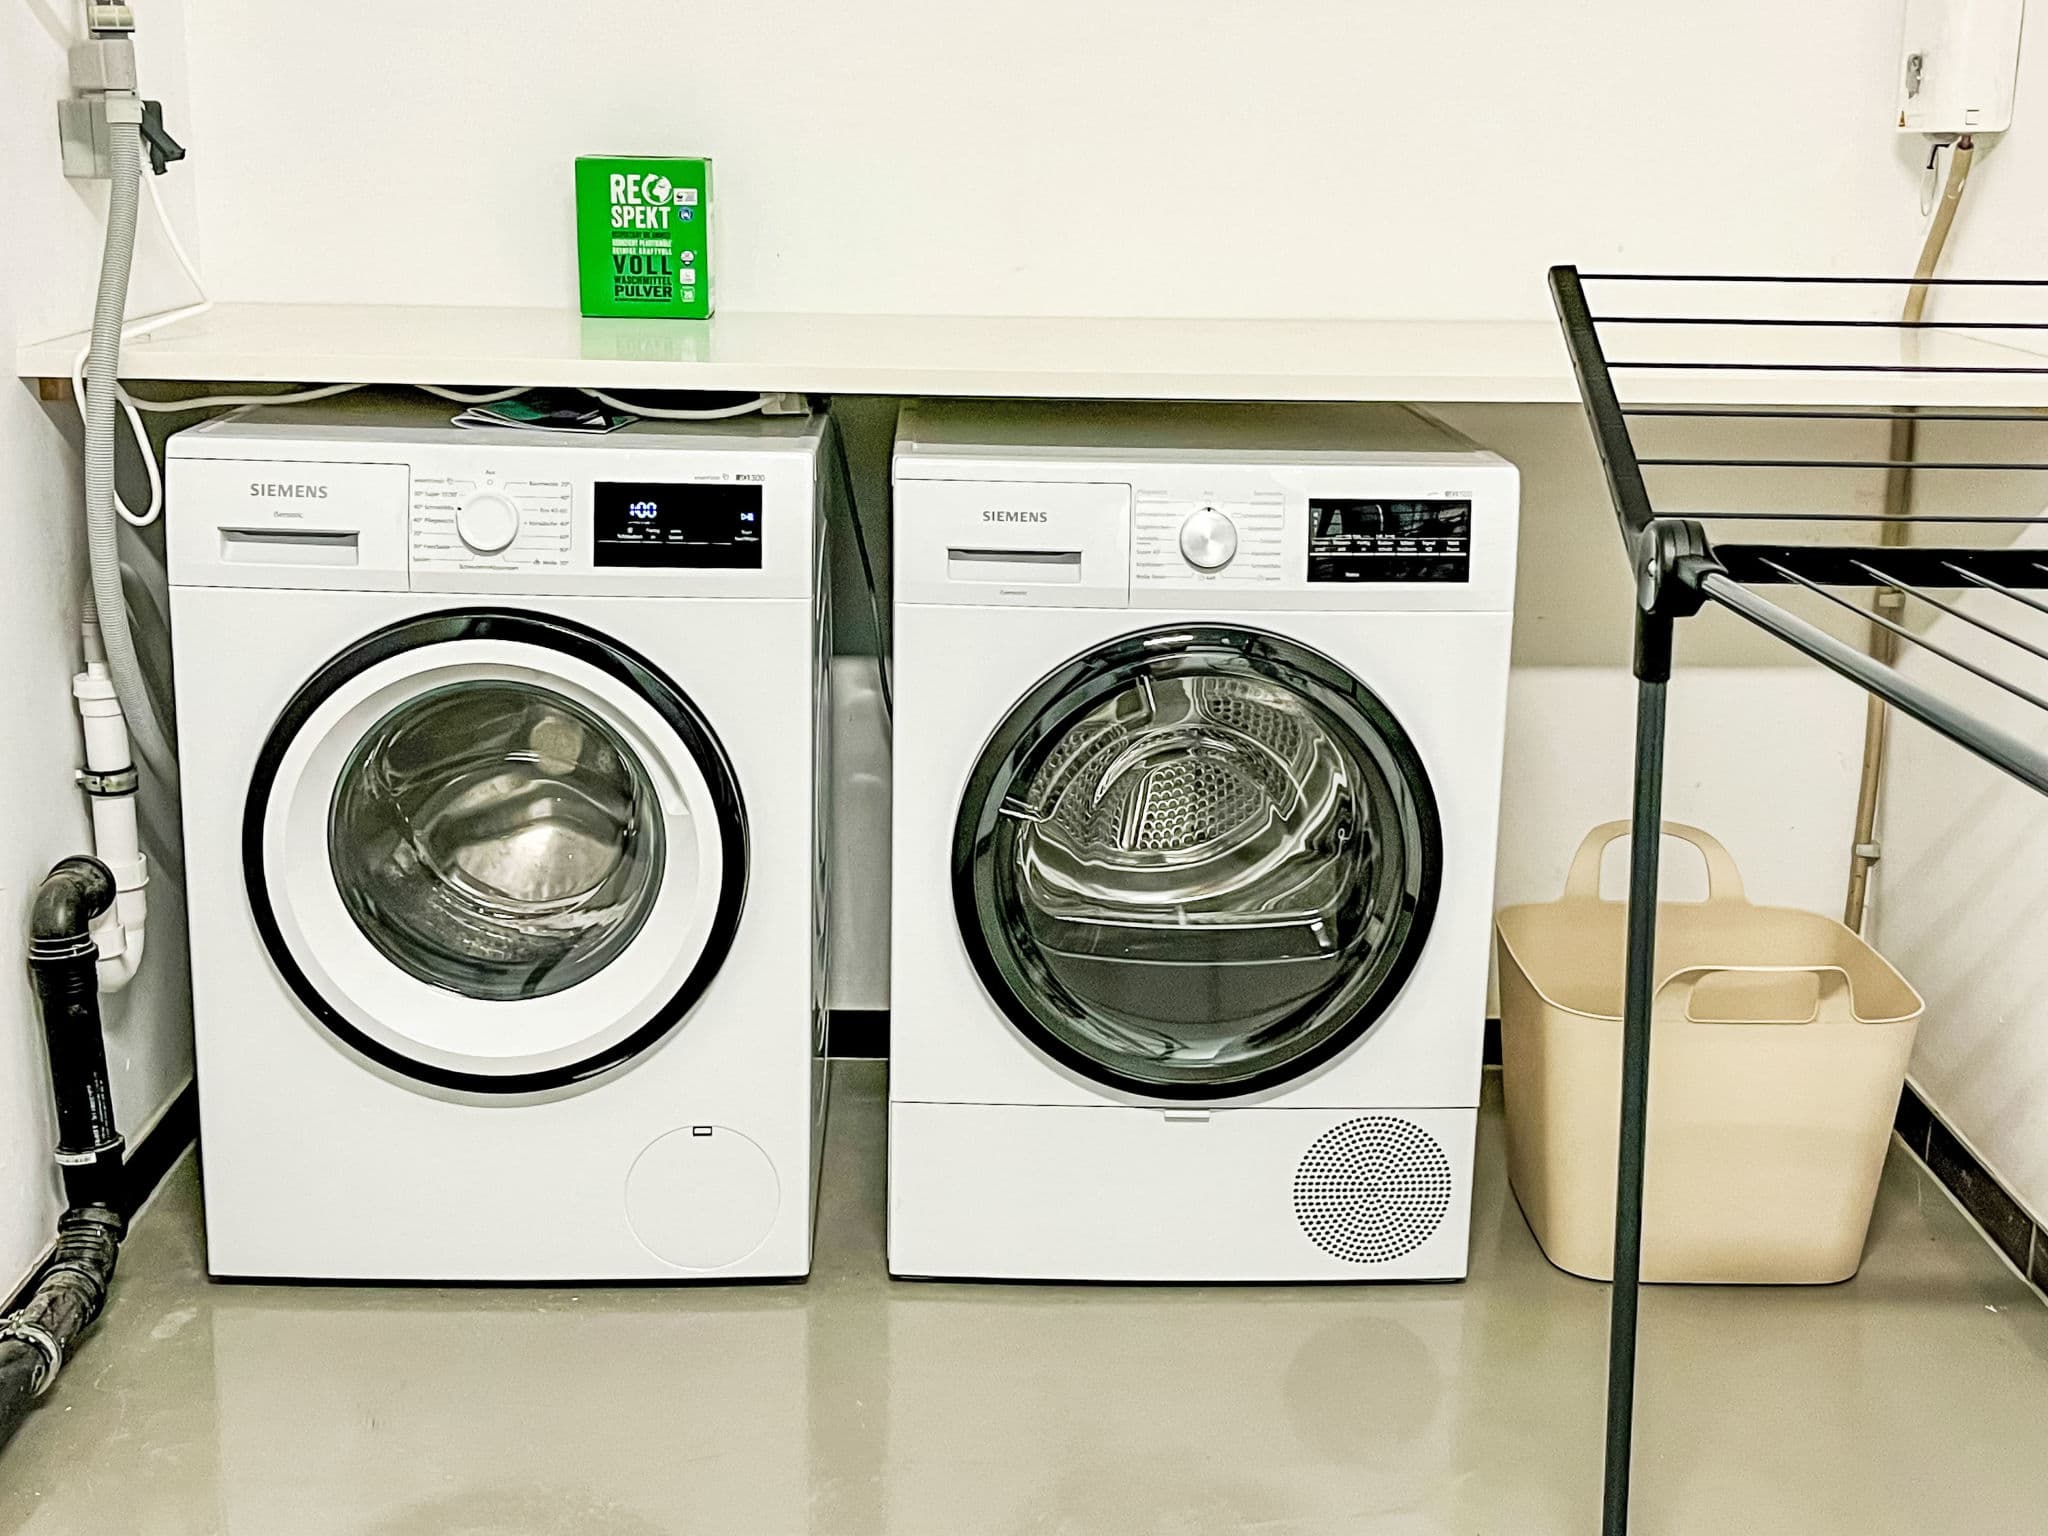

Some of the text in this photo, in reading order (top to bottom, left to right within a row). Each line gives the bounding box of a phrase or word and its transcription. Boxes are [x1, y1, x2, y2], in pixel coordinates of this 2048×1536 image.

[611, 205, 671, 229] SPEKT
[613, 255, 673, 275] VOLL
[615, 285, 673, 297] PULVER
[250, 483, 328, 499] SIEMENS
[982, 510, 1048, 523] SIEMENS
